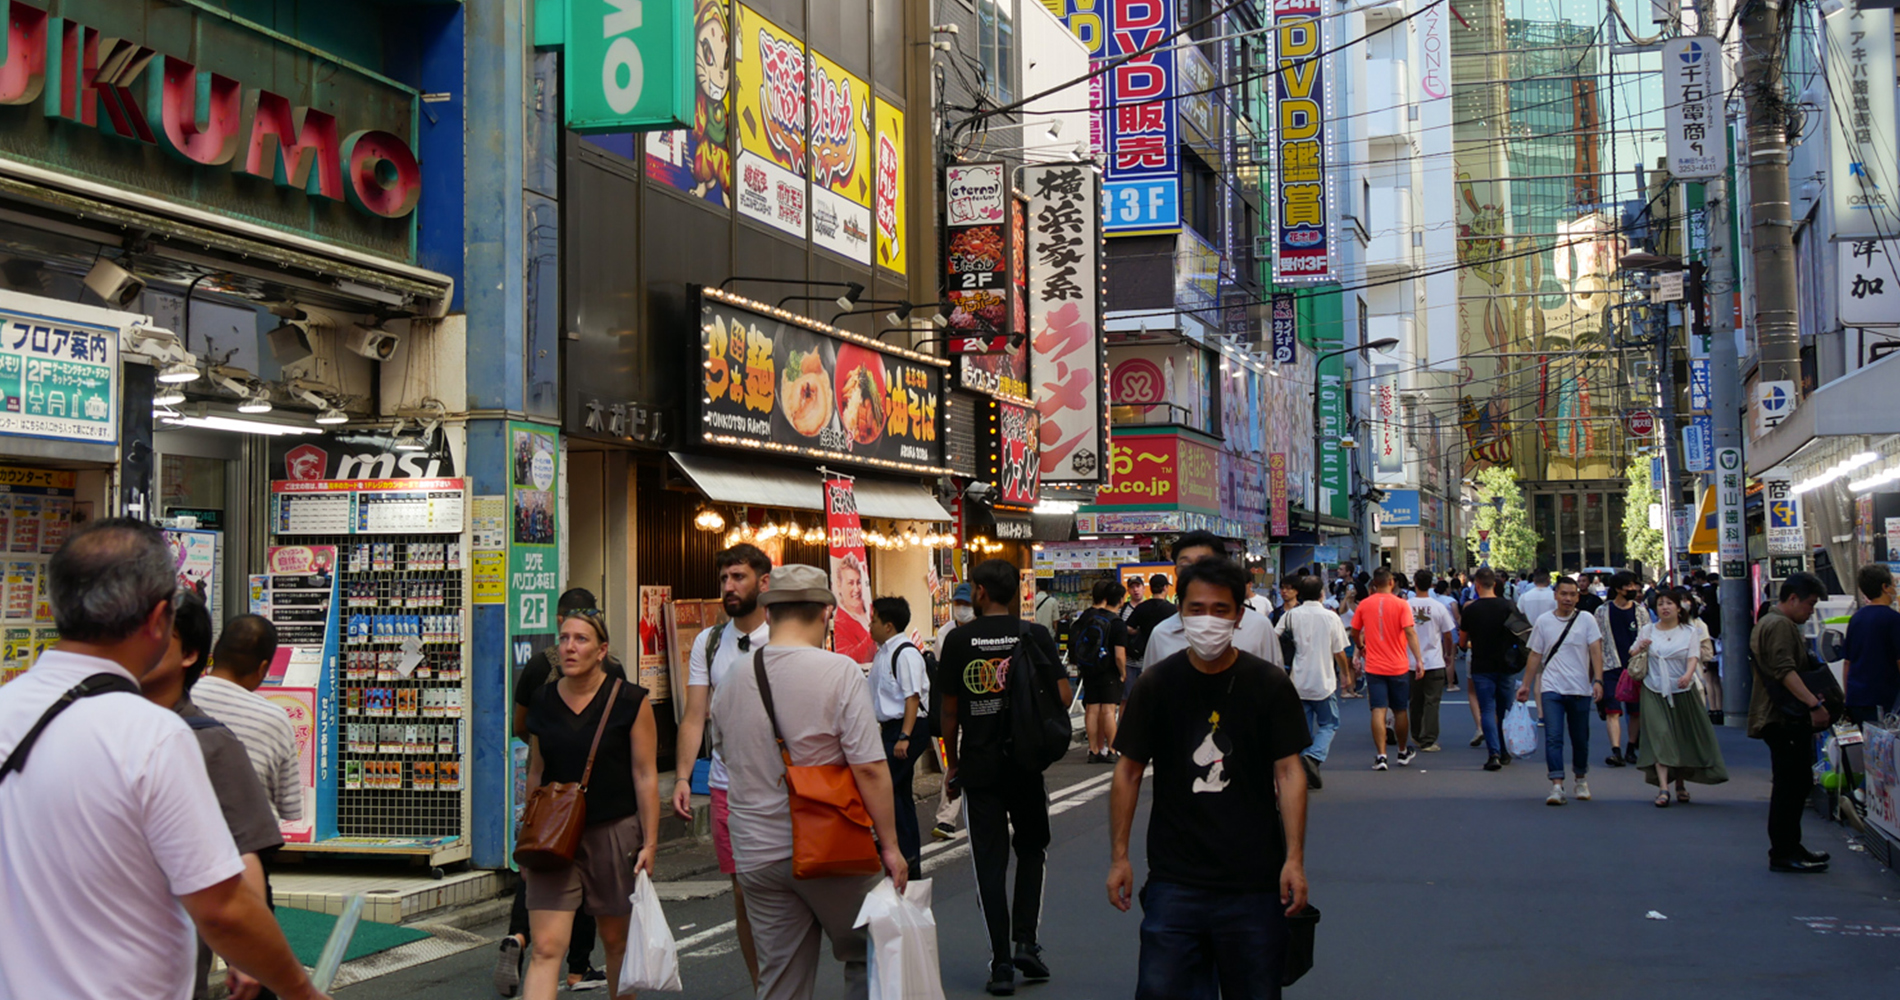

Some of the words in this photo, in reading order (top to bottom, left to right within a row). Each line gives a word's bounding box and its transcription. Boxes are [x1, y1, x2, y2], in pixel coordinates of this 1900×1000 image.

[1680, 65, 1706, 141] 千石電商
[1279, 17, 1321, 227] DVD鑑賞
[1678, 163, 1717, 173] 3253-4411
[951, 183, 999, 197] eternal
[1846, 194, 1887, 205] IOSYS
[1280, 256, 1327, 272] 受付3F
[962, 272, 993, 288] 2F
[13, 323, 107, 363] フロア案内
[1274, 320, 1284, 345] カフェ
[1283, 320, 1293, 346] メイド
[28, 360, 51, 382] 2F
[886, 365, 937, 443] 油そば
[1320, 374, 1341, 497] KOTOBUKIYA
[335, 451, 442, 480] msi
[1001, 437, 1041, 501] ラーメン
[1722, 473, 1740, 543] 福山歯科
[524, 553, 543, 570] ツクモ
[1775, 559, 1799, 568] 外神田
[522, 597, 545, 624] 2F
[514, 642, 532, 666] VR
